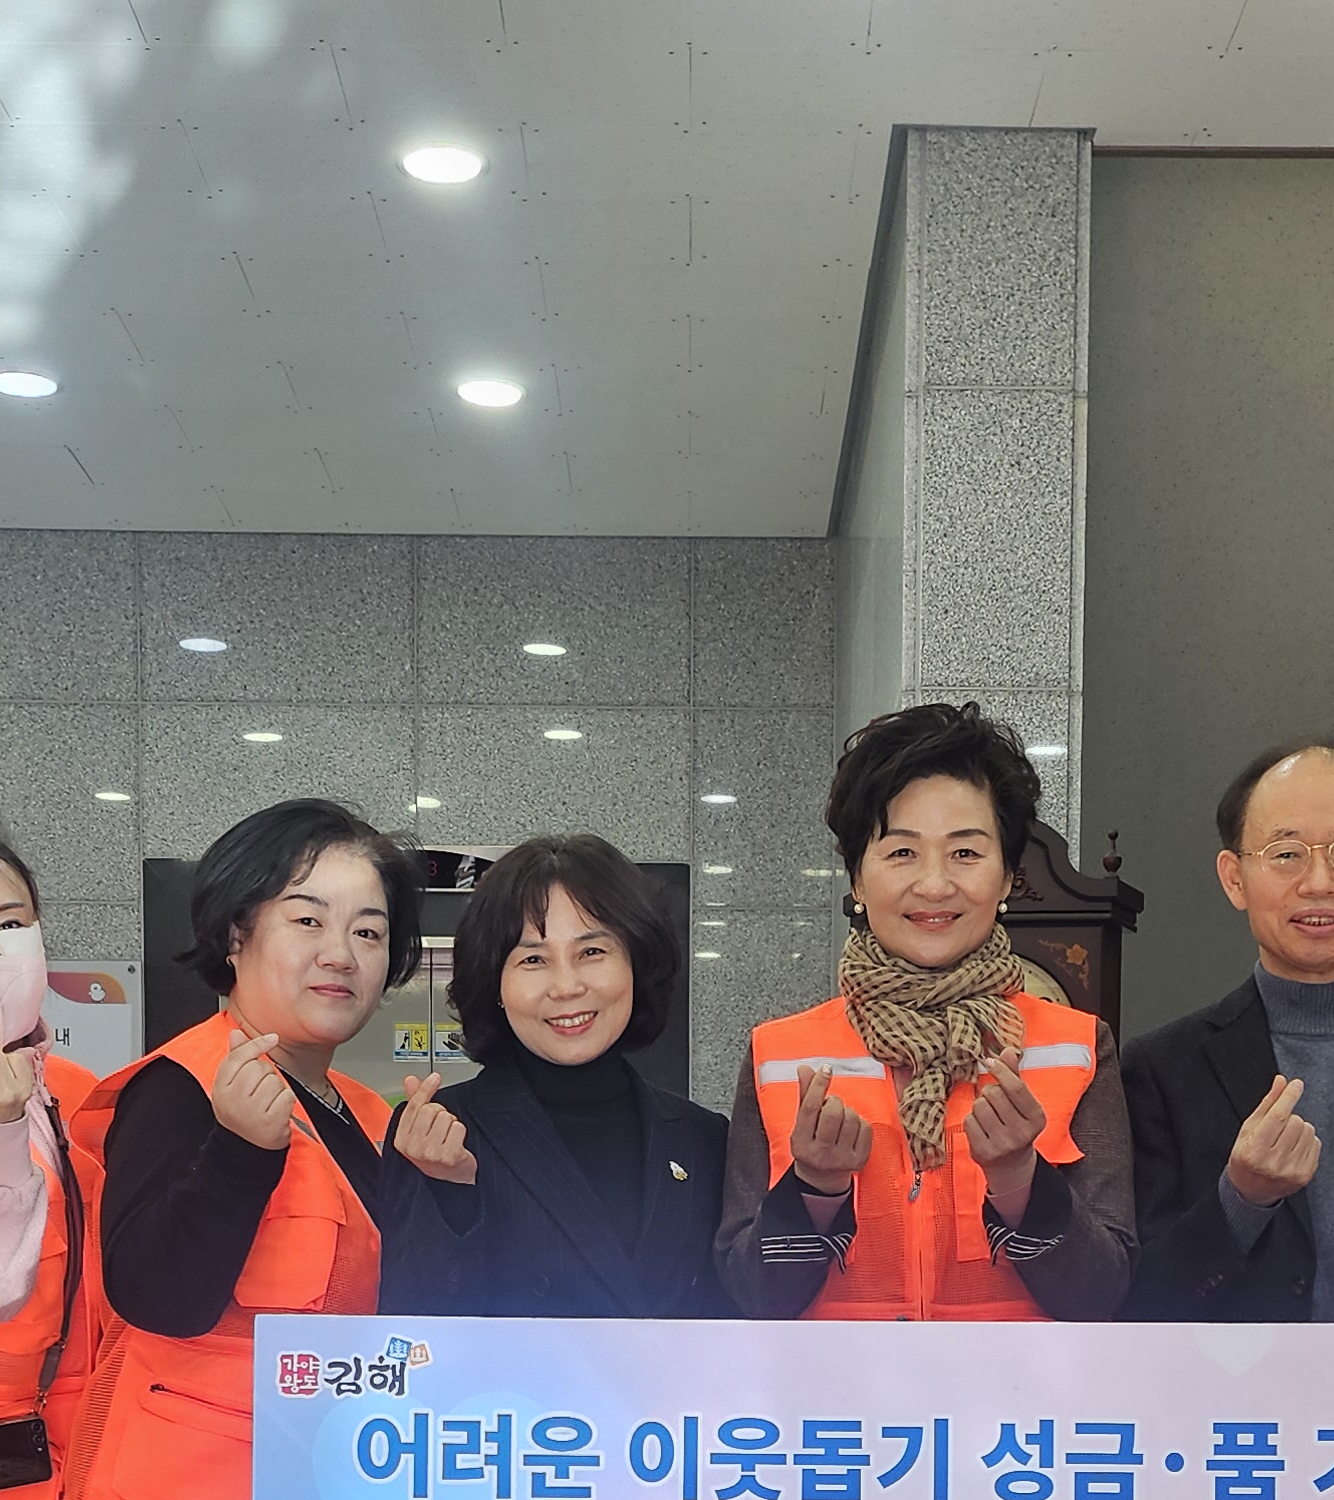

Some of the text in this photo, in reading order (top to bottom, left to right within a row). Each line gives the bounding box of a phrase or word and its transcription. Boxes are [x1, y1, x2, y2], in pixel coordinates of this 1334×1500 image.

[282, 1355, 320, 1374] 가야
[324, 1355, 406, 1396] 김해
[279, 1375, 320, 1394] 왕도
[356, 1412, 601, 1500] 어려운
